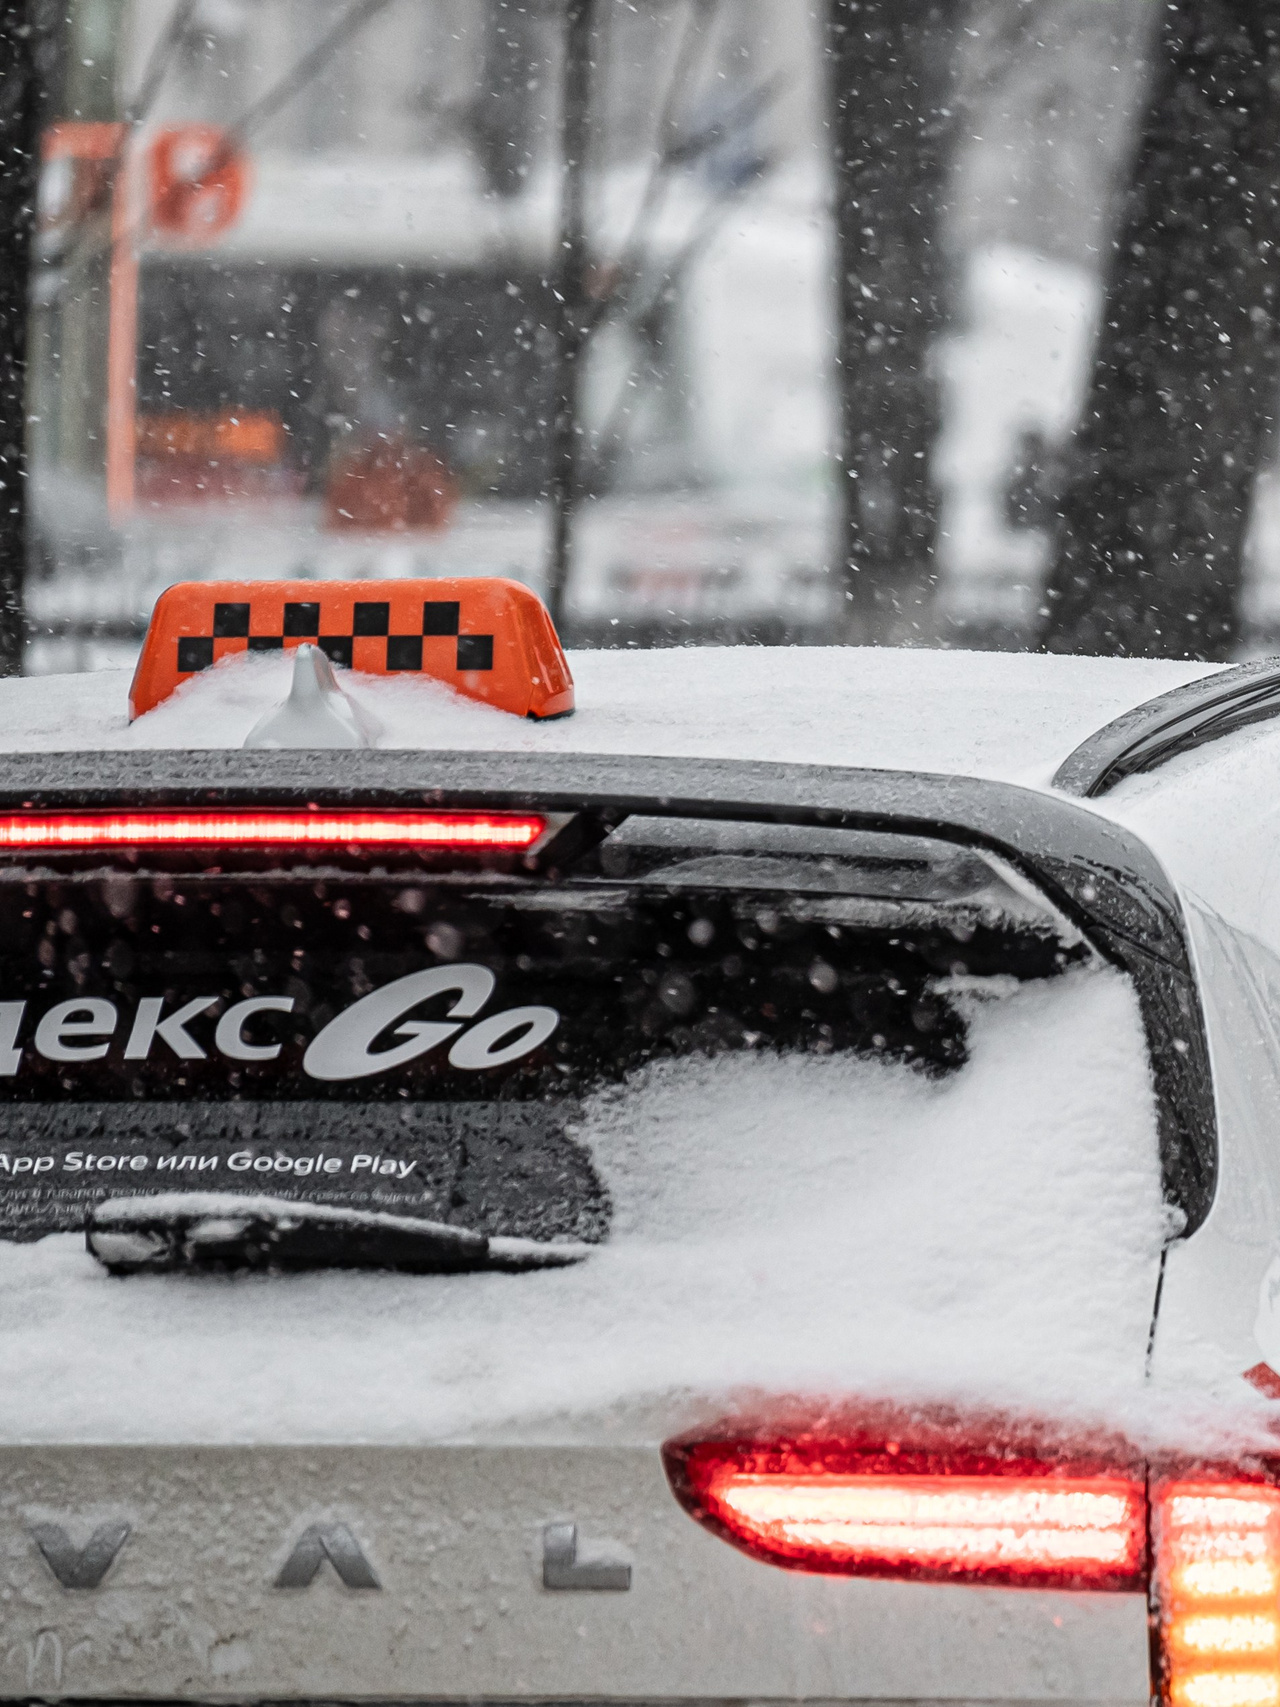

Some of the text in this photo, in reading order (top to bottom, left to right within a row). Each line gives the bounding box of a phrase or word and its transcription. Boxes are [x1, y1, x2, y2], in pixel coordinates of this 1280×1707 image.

[303, 962, 560, 1081] Go
[62, 1151, 149, 1171] Store
[156, 1155, 219, 1171] или
[227, 1151, 342, 1176] Google
[350, 1154, 417, 1179] Play
